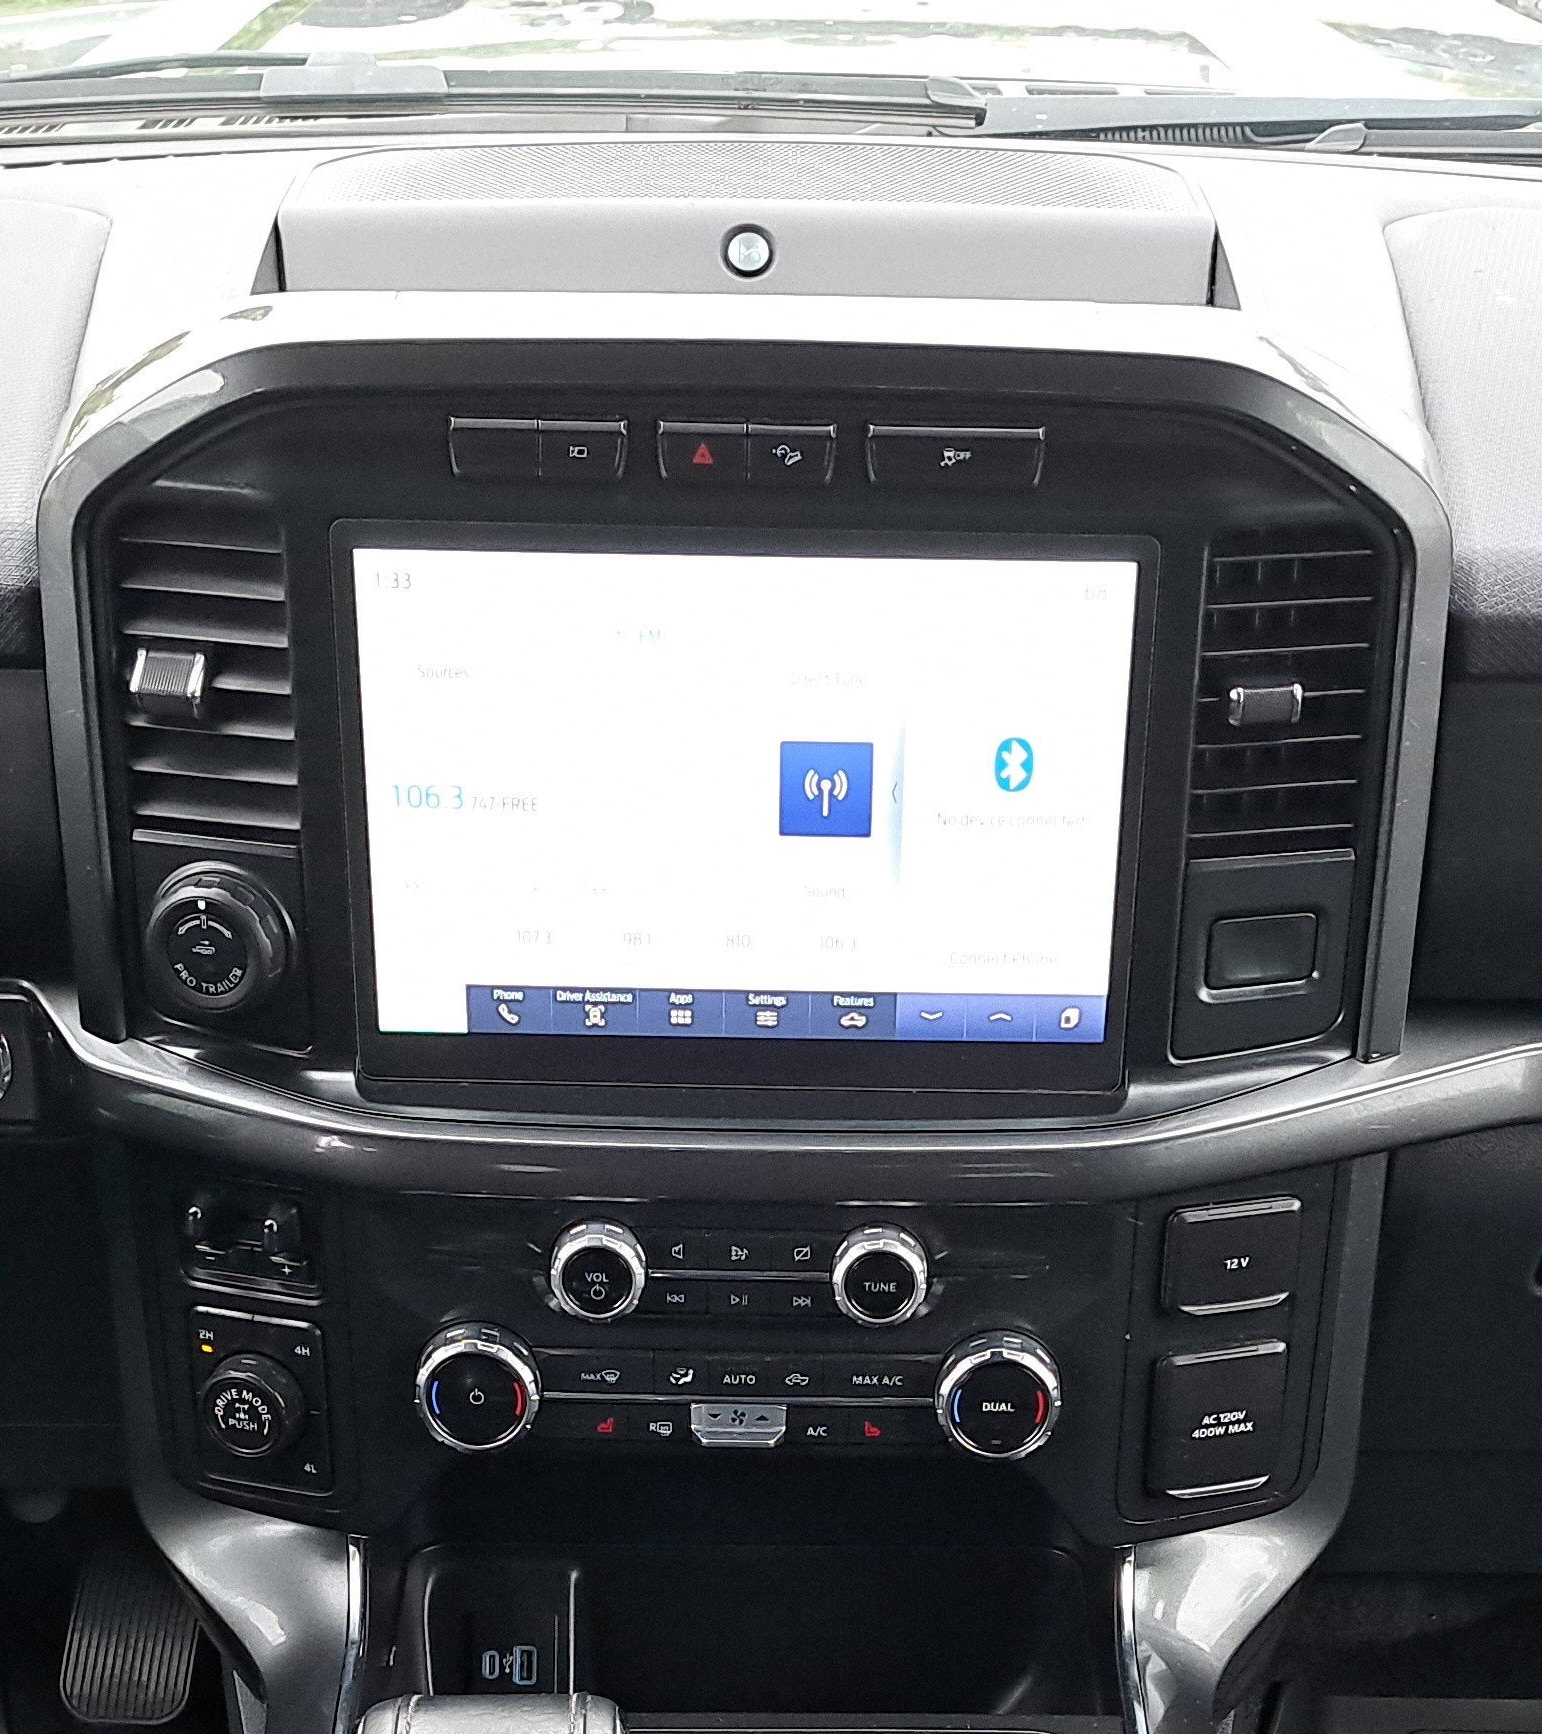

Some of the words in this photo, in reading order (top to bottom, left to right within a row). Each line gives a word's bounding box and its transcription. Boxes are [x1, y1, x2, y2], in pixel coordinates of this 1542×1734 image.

[391, 784, 465, 810] 106.3
[173, 962, 197, 987] PRO
[200, 966, 244, 994] TRAILER
[492, 989, 525, 1002] Phone
[556, 990, 584, 1003] Driver
[584, 991, 634, 1004] Assistance
[669, 992, 694, 1006] Apps
[747, 993, 787, 1007] Settings
[833, 995, 875, 1008] Features
[584, 1270, 610, 1284] VOL
[862, 1281, 897, 1294] TUNE
[293, 1345, 311, 1357] 4H
[722, 1374, 756, 1385] AUTO
[852, 1374, 880, 1386] MAX
[881, 1374, 904, 1387] A/C
[214, 1388, 240, 1416] DRIVE
[241, 1389, 272, 1422] MODE
[981, 1400, 1016, 1413] DUAL
[228, 1418, 258, 1432] PUSH
[1201, 1413, 1218, 1426] AC
[1218, 1410, 1247, 1424] 120V
[806, 1426, 829, 1437] A/C
[1191, 1425, 1227, 1440] 400W
[1227, 1421, 1254, 1435] MAX
